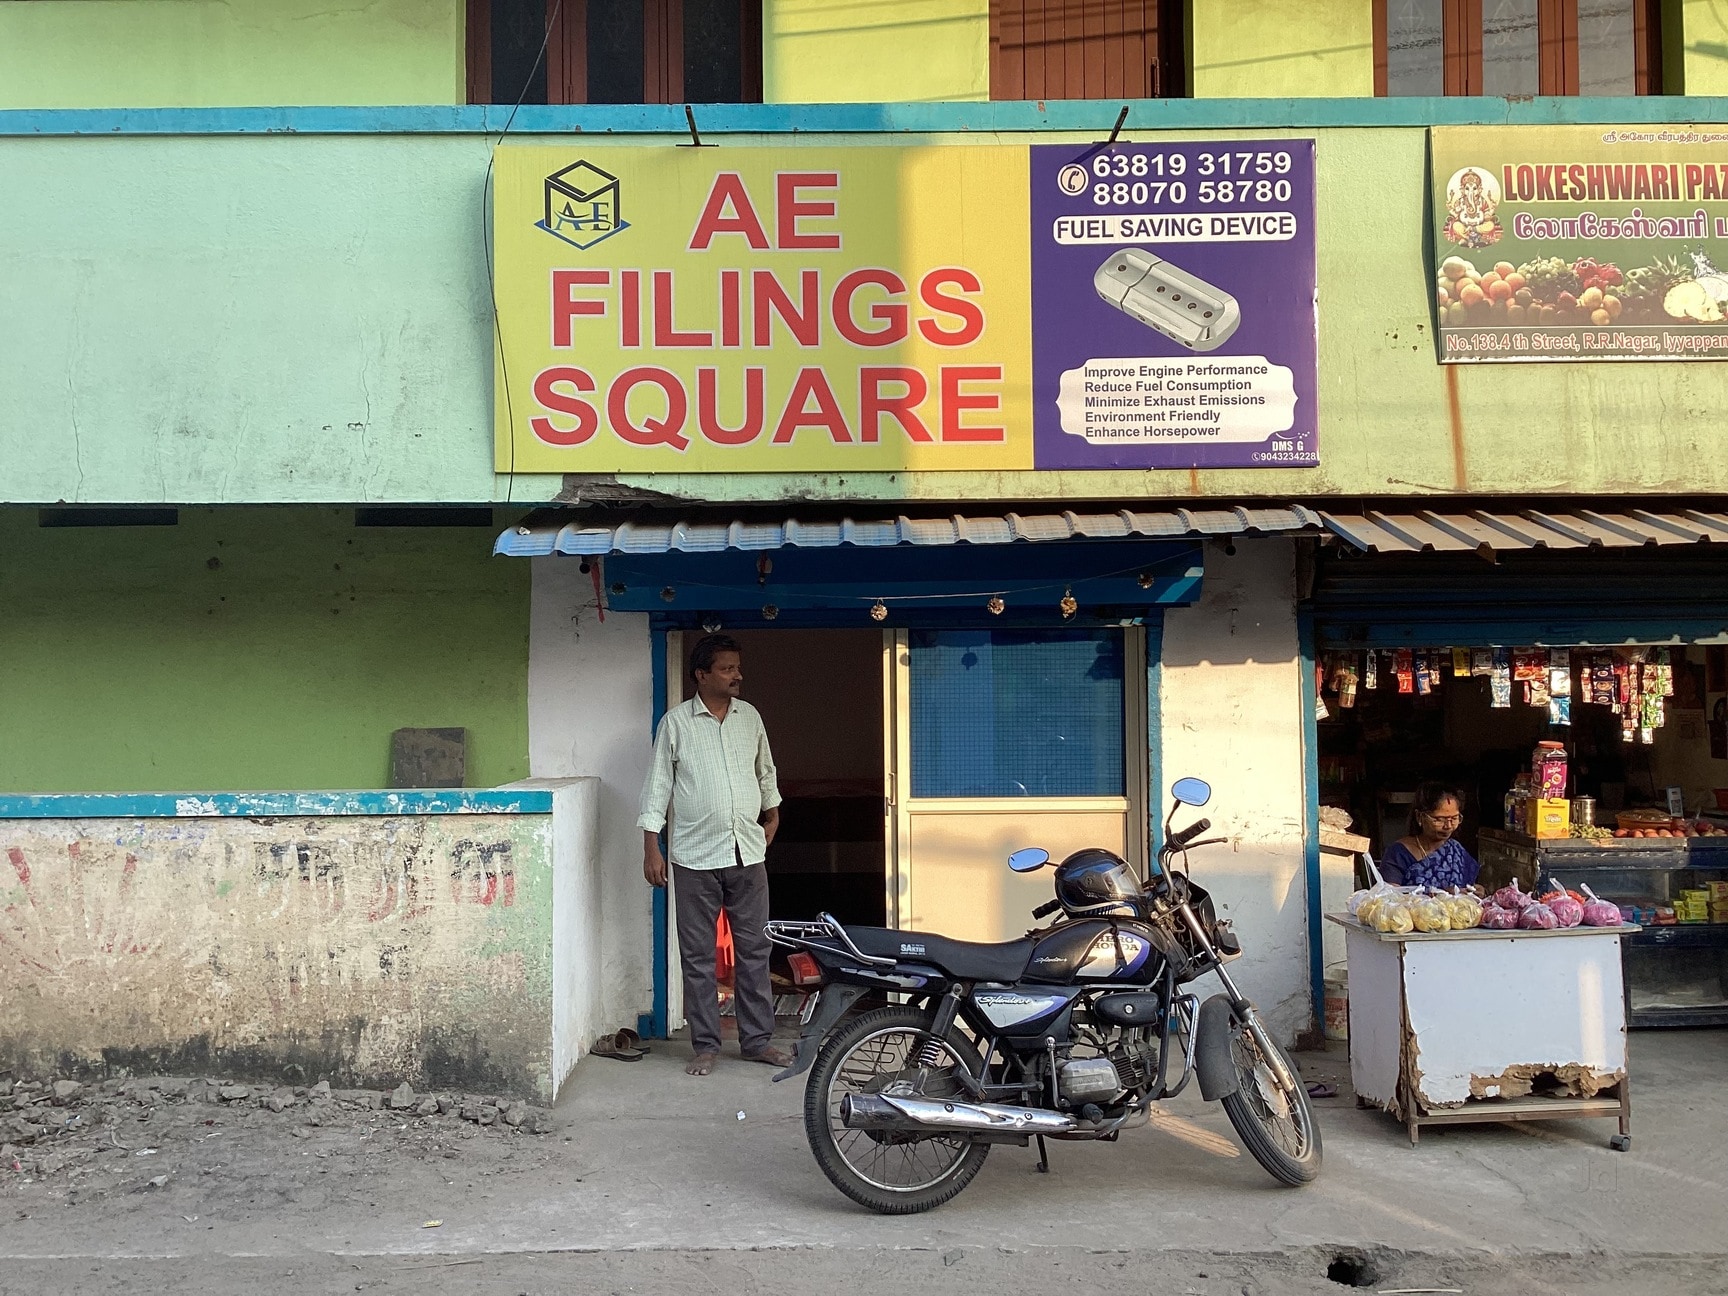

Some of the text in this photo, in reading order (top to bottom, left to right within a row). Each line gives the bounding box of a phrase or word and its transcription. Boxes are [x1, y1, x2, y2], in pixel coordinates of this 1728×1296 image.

[1093, 152, 1292, 178] 63819 31759
[1093, 180, 1292, 205] 88070 58780
[1503, 164, 1680, 201] LOKESHWARI
[688, 172, 842, 250] AE
[1057, 216, 1293, 239] FUEL SAVING DEVICE
[1514, 208, 1708, 239] லோகேஸ்வரி
[552, 267, 986, 348] FILINGS
[1512, 333, 1529, 350] th
[1532, 333, 1580, 352] Street,
[1583, 332, 1661, 353] R.R.Nagar,
[1084, 364, 1268, 380] Improve Engine Performance
[1084, 379, 1252, 394] Reduce Fuel Consumption
[531, 365, 1006, 453] SQUARE
[1085, 394, 1266, 408] Minimize Exhaust Emissions
[1085, 409, 1221, 424] Environment Friendly
[1085, 425, 1221, 439] Enhance Horsepower
[1260, 452, 1317, 461] 9043234228
[1271, 441, 1304, 451] DMS G
